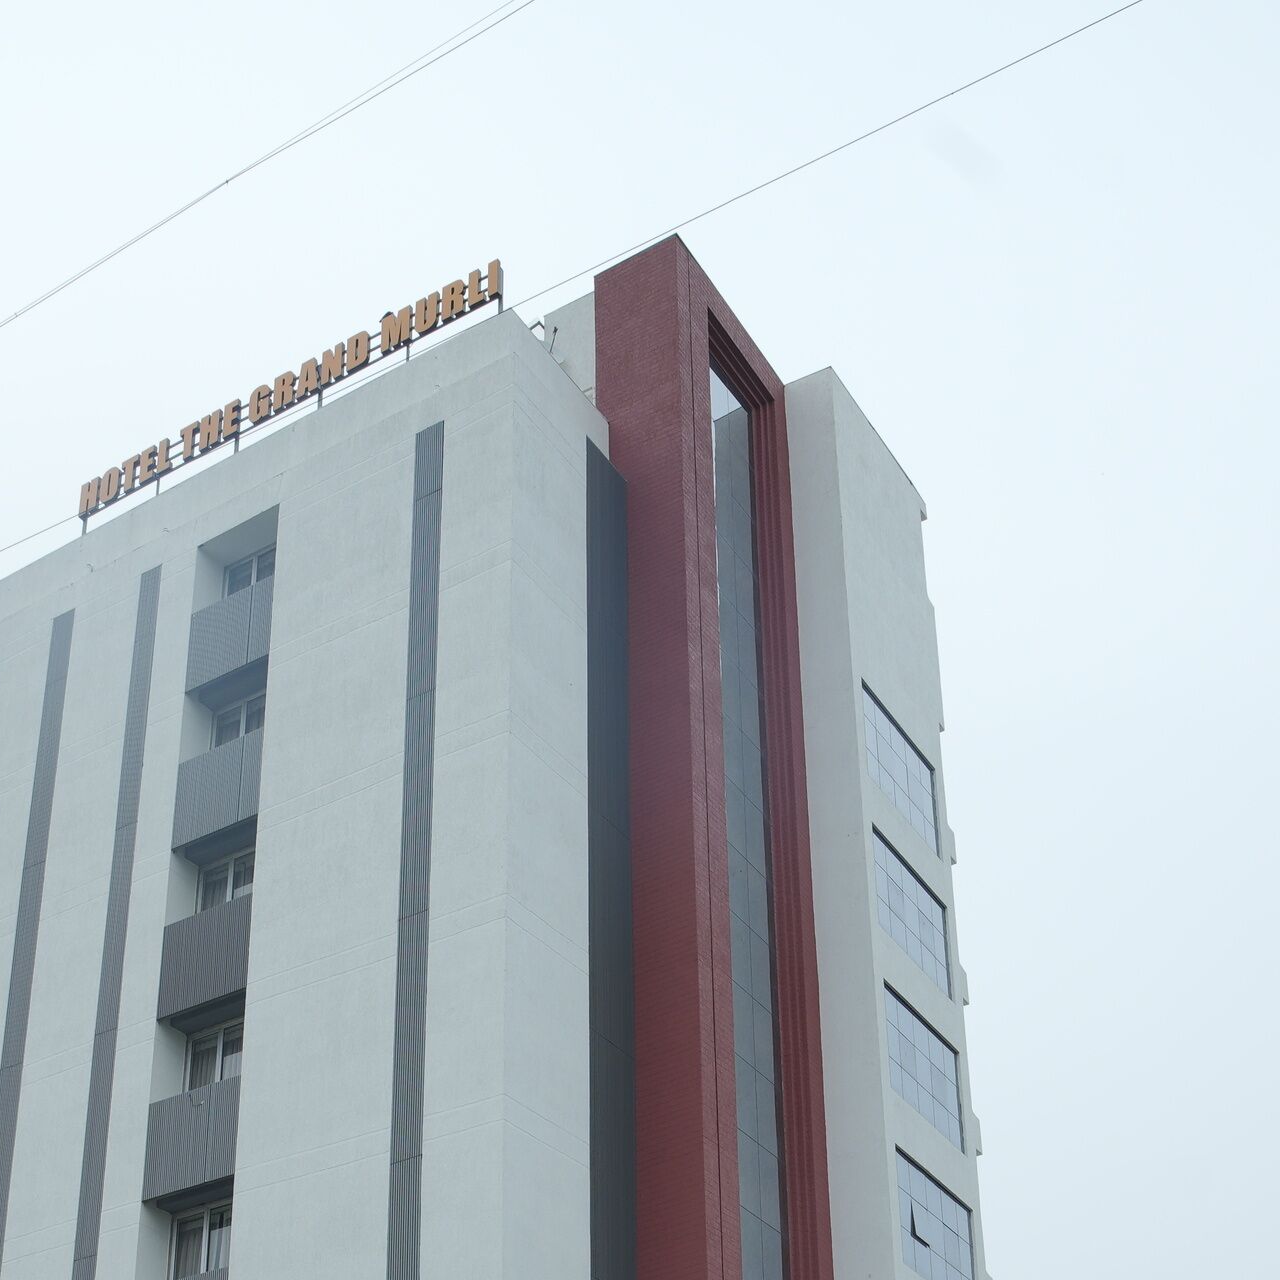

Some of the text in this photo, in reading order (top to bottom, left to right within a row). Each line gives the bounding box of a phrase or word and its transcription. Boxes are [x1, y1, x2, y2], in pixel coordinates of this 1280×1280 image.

[79, 258, 503, 519] HOTEL THE GRAND MURLI
